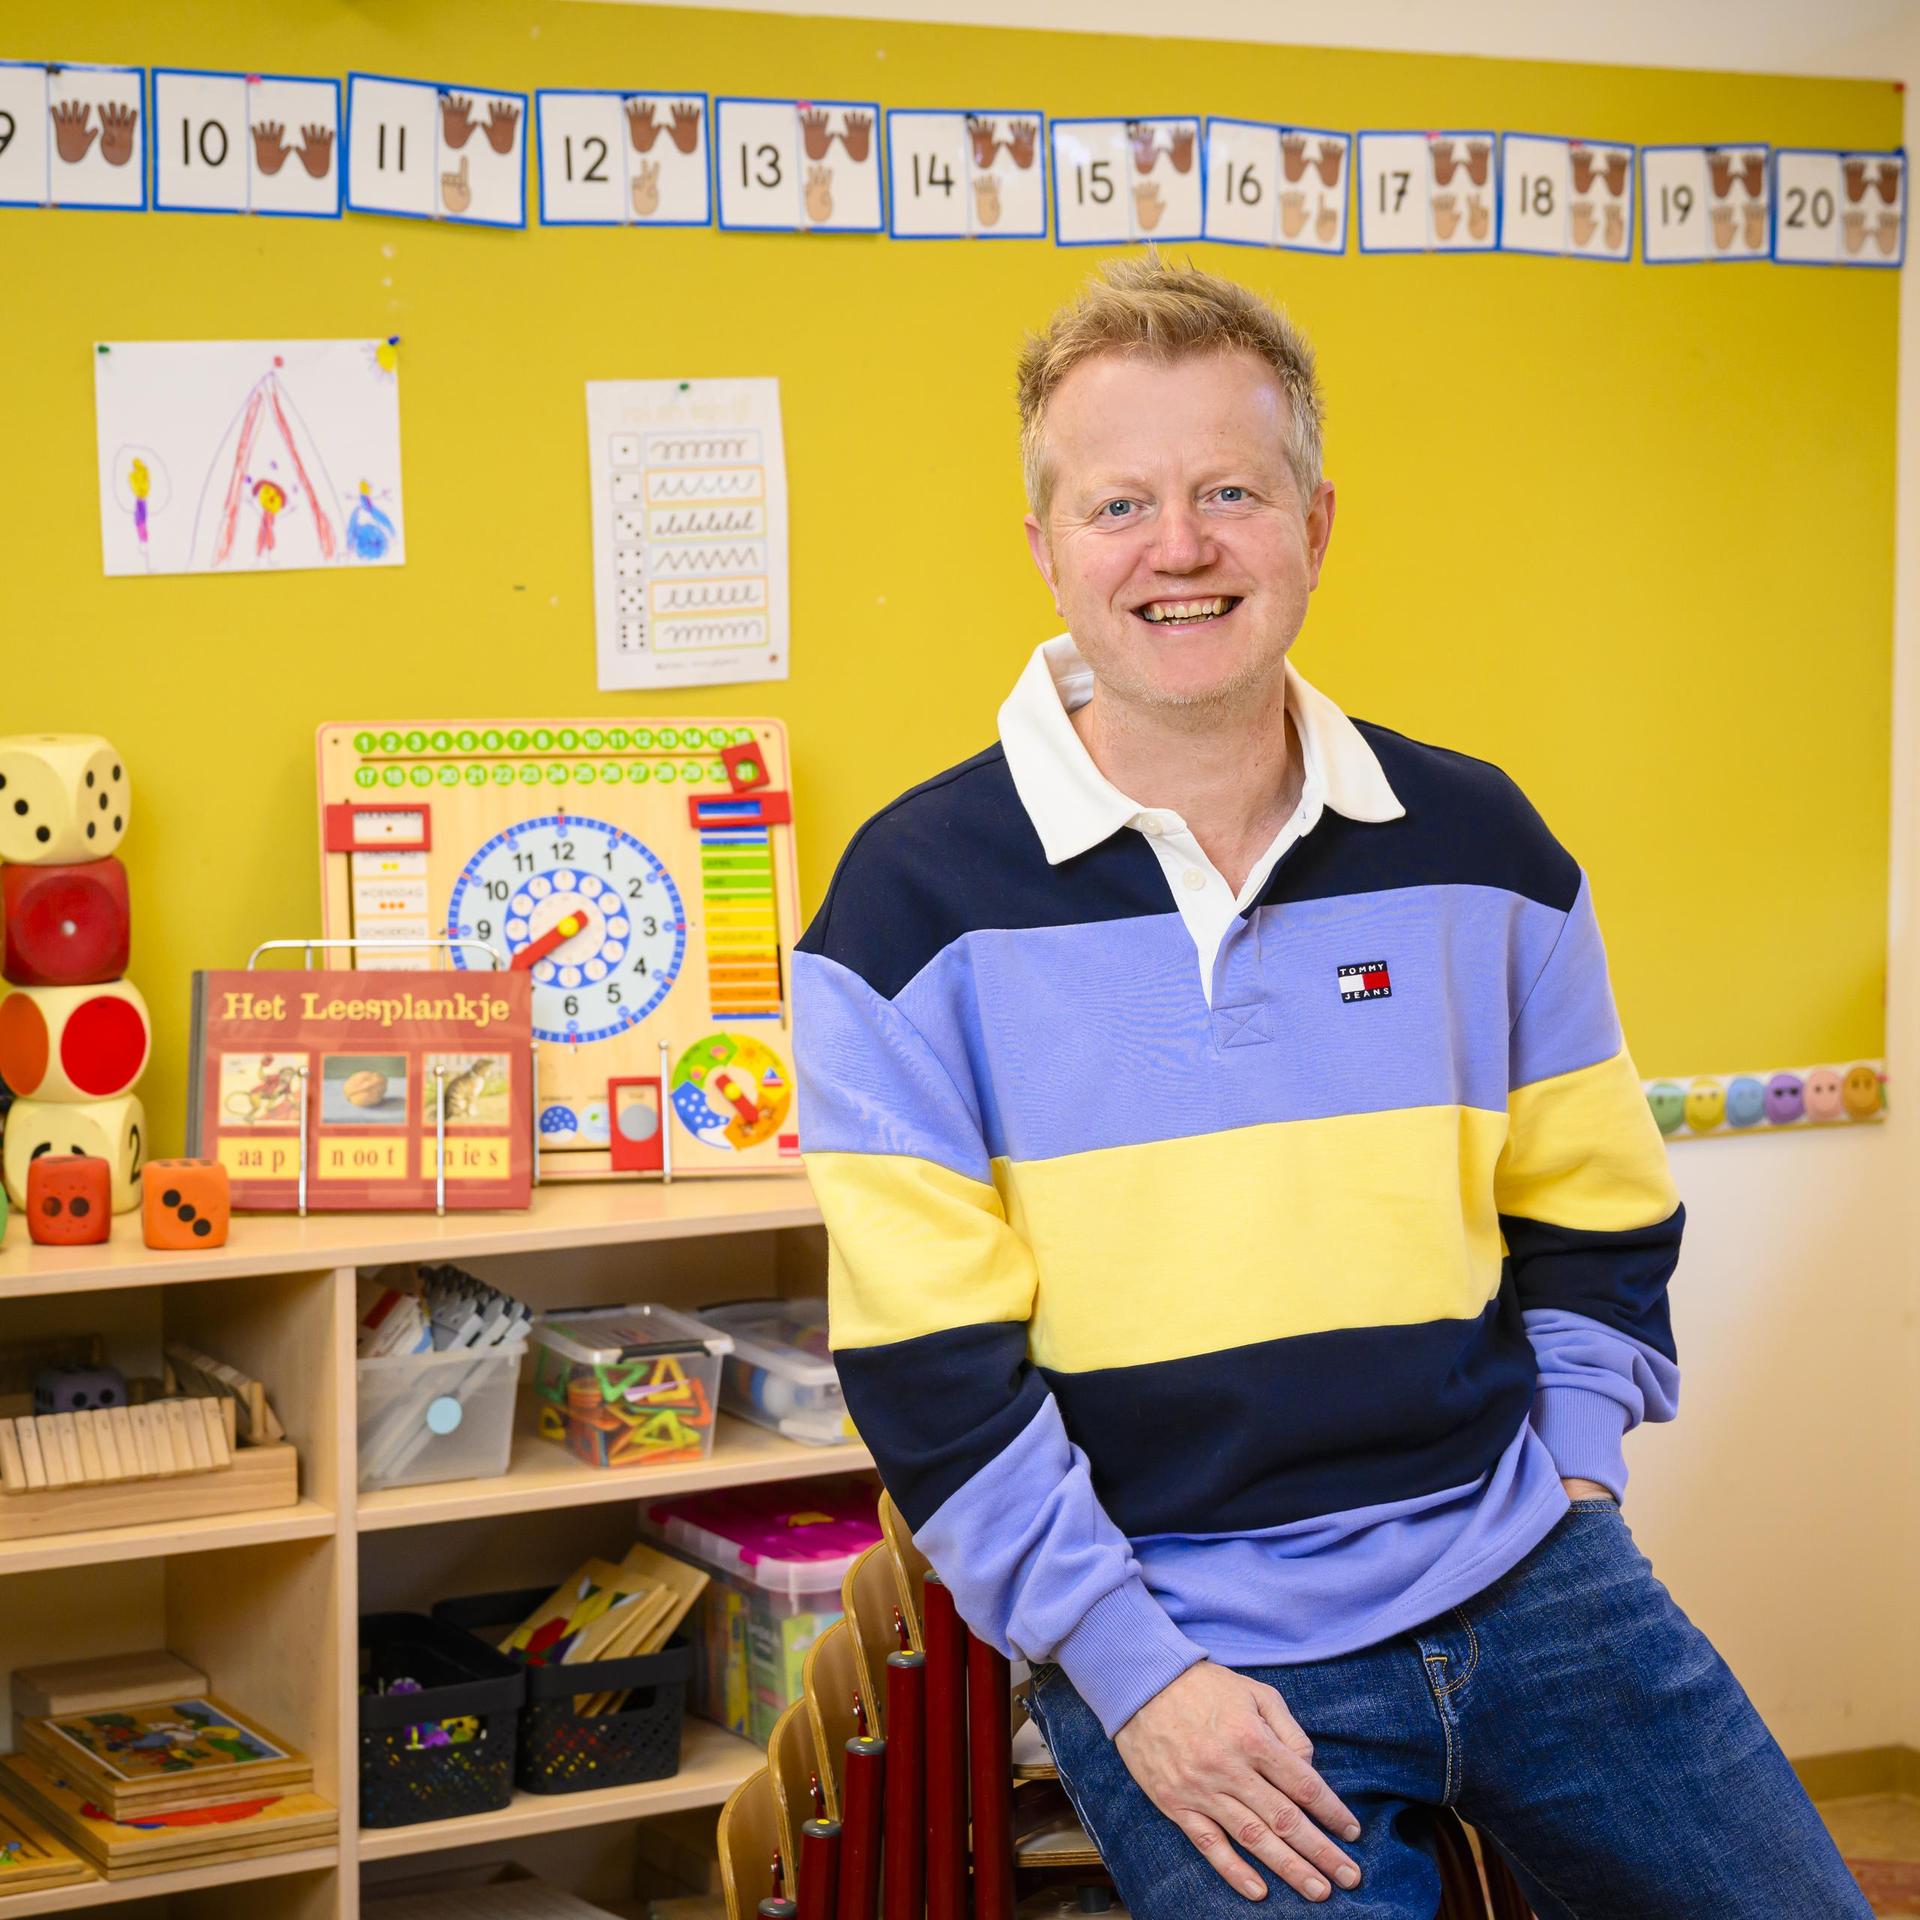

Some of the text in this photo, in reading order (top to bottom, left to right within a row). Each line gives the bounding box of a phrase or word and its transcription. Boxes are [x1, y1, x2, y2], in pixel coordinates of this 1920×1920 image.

[182, 118, 229, 167] 10
[378, 123, 406, 172] 11
[565, 136, 609, 182] 12
[741, 144, 782, 188] 13
[913, 154, 954, 197] 14
[1077, 161, 1114, 206] 15
[1227, 163, 1262, 205] 16
[1379, 172, 1411, 212] 17
[1520, 176, 1554, 216] 18
[1662, 185, 1693, 224] 19
[1785, 188, 1834, 228] 20
[361, 735, 369, 750] 1
[385, 735, 396, 750] 2
[411, 735, 422, 750] 3
[436, 735, 447, 750] 4
[512, 734, 522, 748] 7
[612, 733, 625, 746] 11
[637, 732, 651, 746] 12
[662, 732, 676, 746] 13
[687, 732, 701, 746] 14
[359, 769, 375, 783] 17
[470, 768, 484, 781] 21
[495, 768, 512, 781] 22
[551, 842, 575, 861] 12
[603, 852, 613, 870] 1
[513, 853, 535, 872] 11
[484, 880, 509, 901] 10
[628, 878, 643, 898] 2
[477, 919, 491, 940] 9
[643, 916, 657, 937] 3
[633, 957, 647, 976] 4
[1340, 963, 1384, 976] TOMMY
[607, 983, 621, 1003] 5
[1344, 987, 1389, 1000] JEANS
[222, 991, 510, 1027] Het Leesplankje
[564, 996, 579, 1016] 6
[129, 1123, 141, 1185] 2
